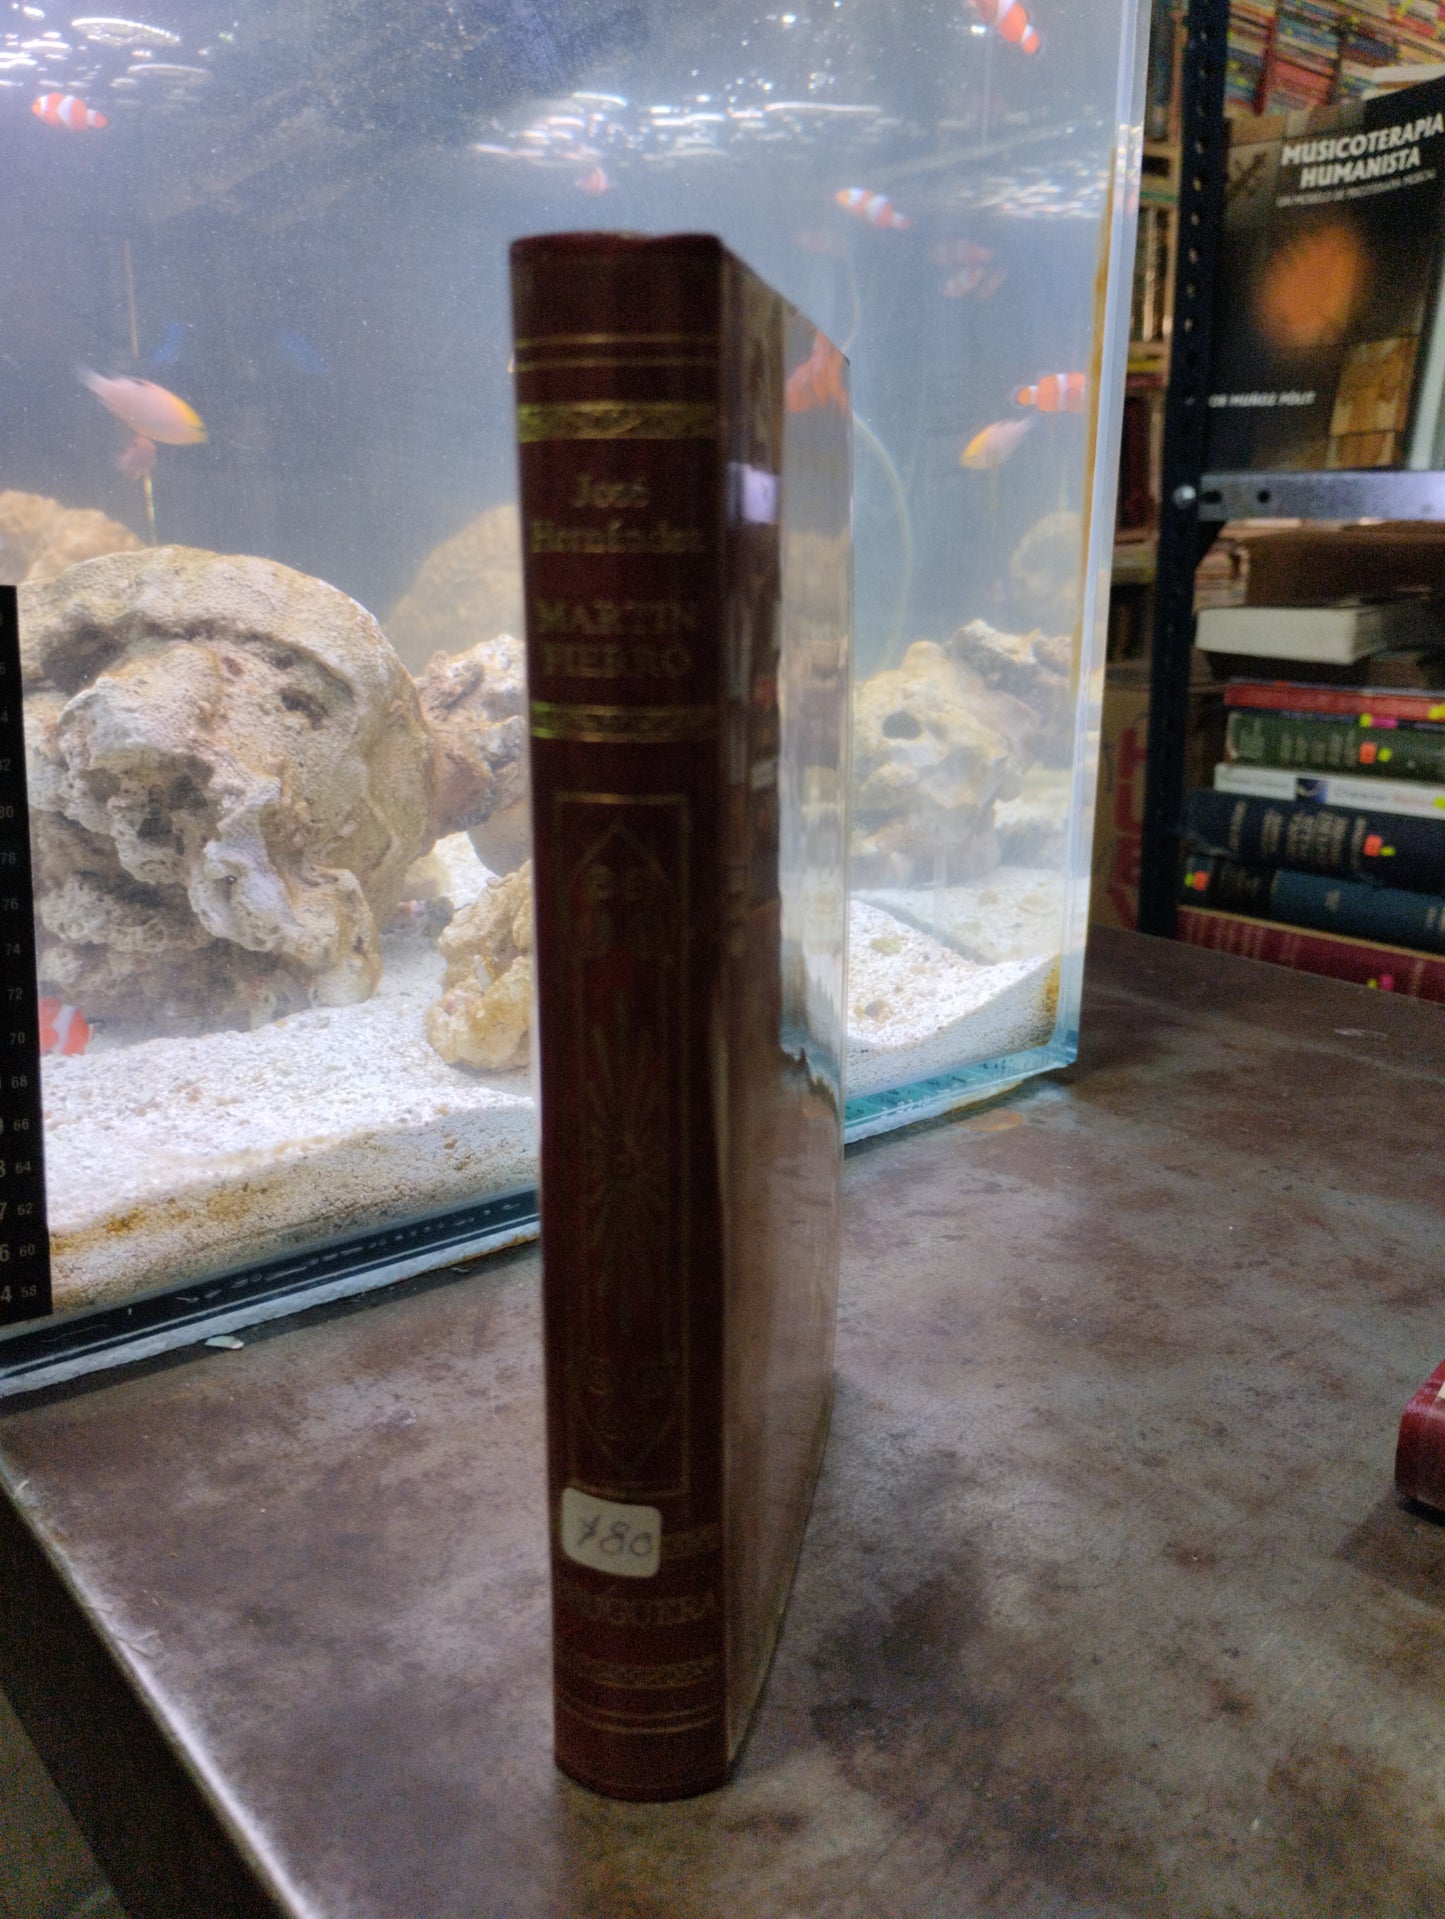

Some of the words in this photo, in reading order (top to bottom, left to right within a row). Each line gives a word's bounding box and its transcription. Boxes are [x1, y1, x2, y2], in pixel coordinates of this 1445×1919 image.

[1280, 112, 1445, 166] MUSICOTERAPIA
[1299, 146, 1421, 189] HUMANISTA
[1, 852, 17, 865] 78
[4, 898, 19, 911] 76
[6, 943, 21, 956] 74
[8, 987, 23, 1000] 72
[9, 1031, 26, 1045] 70
[10, 1074, 28, 1089] 68
[13, 1117, 30, 1132] 66
[15, 1161, 32, 1175] 64
[17, 1202, 33, 1216] 62
[19, 1244, 35, 1257] 60
[21, 1284, 37, 1298] 58
